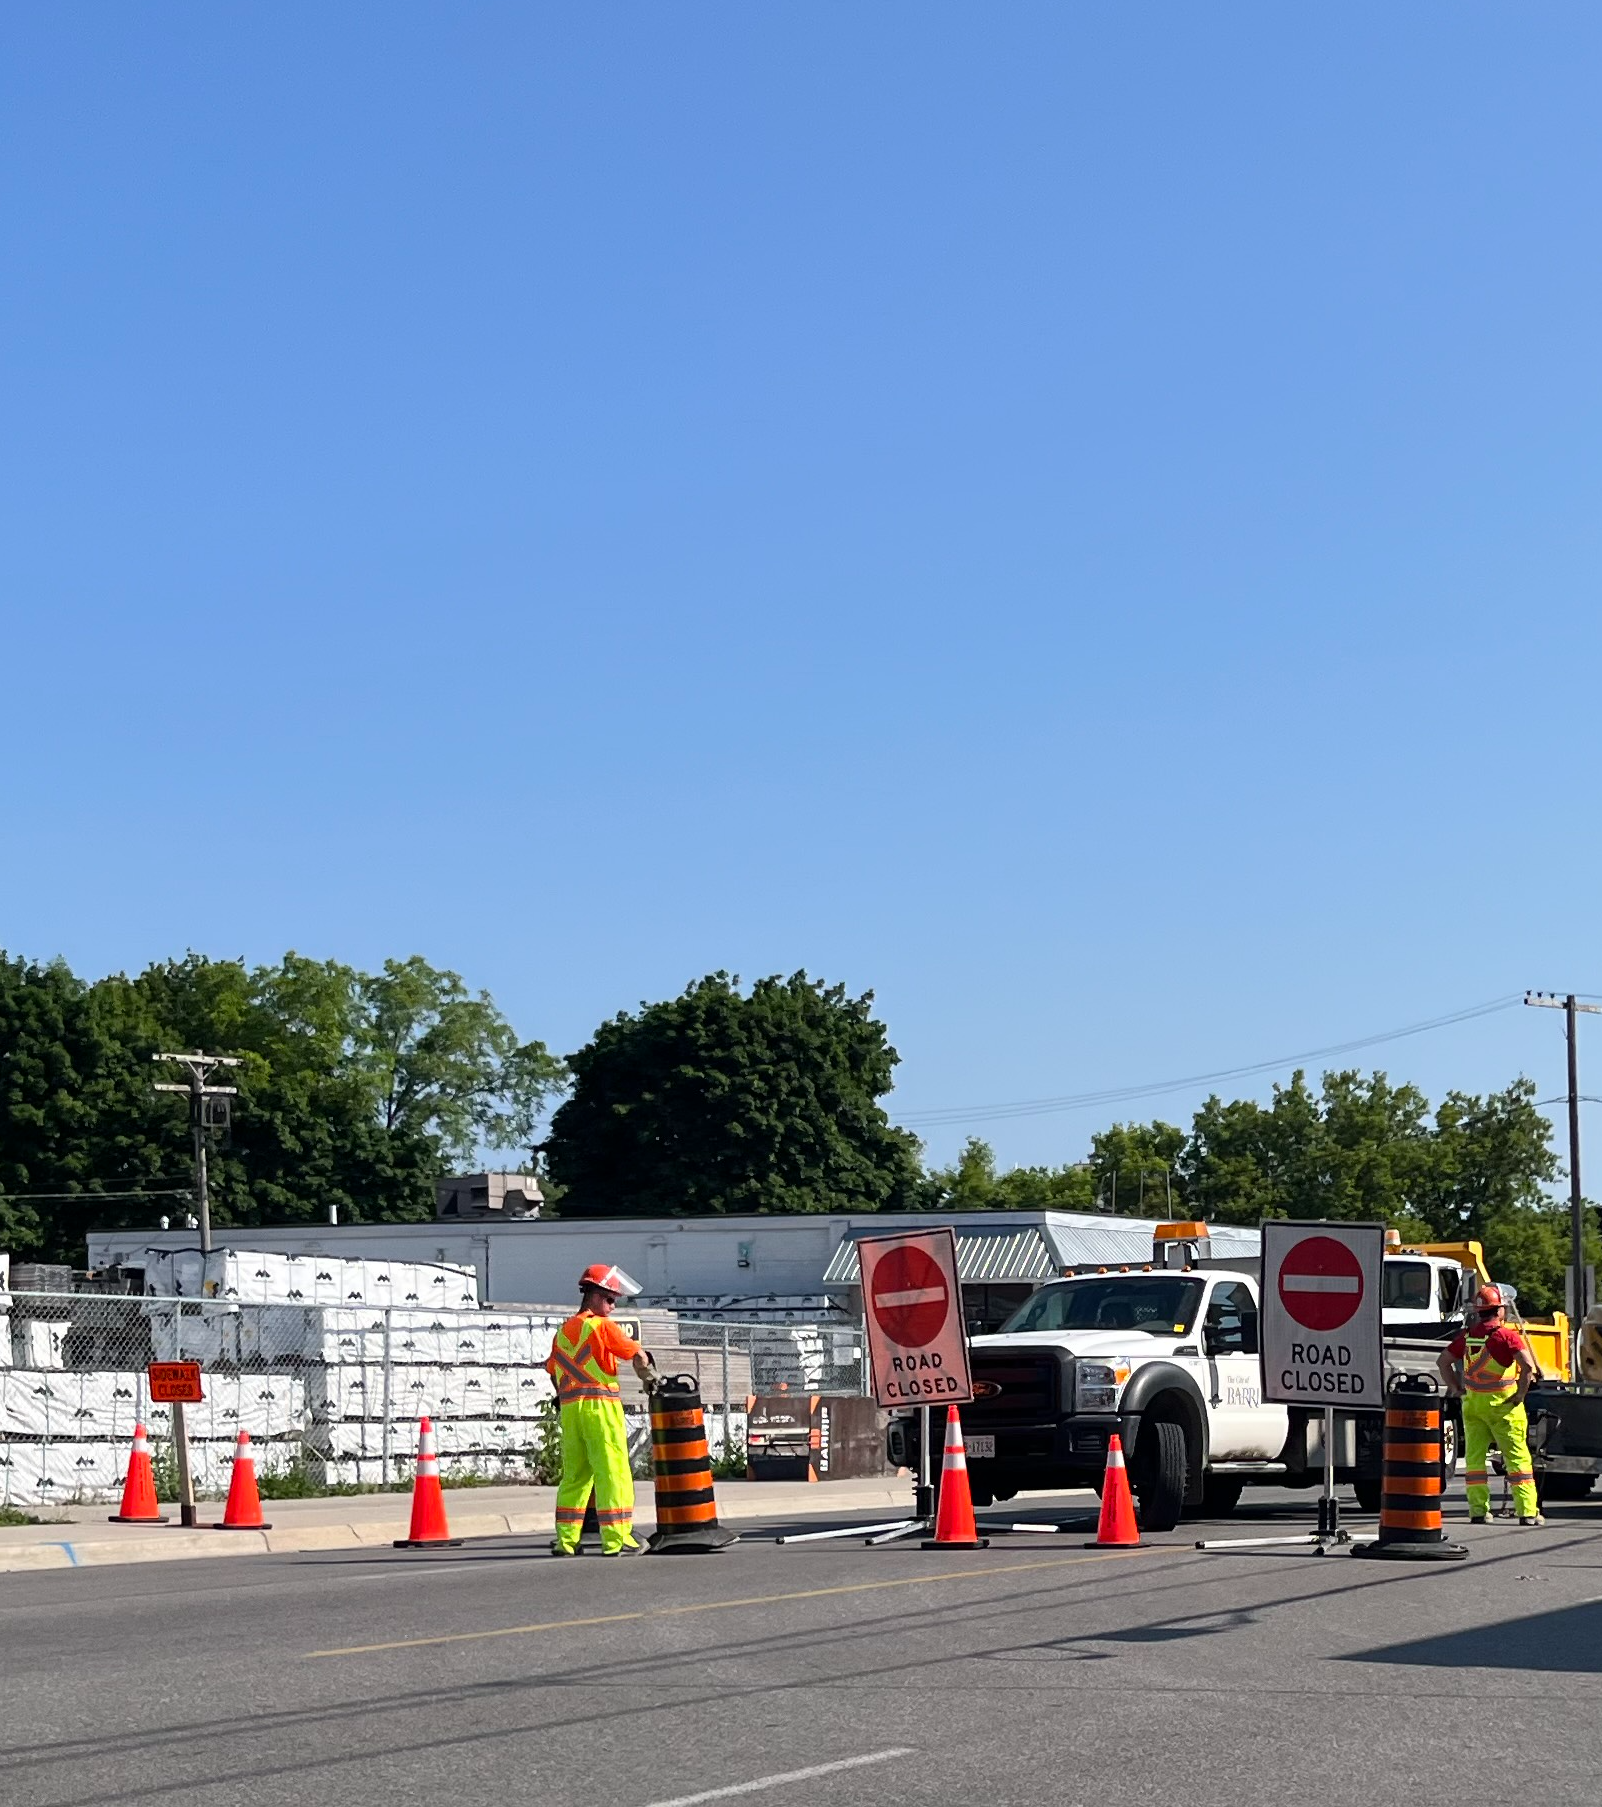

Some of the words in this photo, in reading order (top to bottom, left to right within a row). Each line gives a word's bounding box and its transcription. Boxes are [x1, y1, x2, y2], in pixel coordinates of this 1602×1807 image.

[892, 1353, 942, 1372] ROAD
[1291, 1343, 1351, 1366] ROAD
[158, 1384, 194, 1397] CLOSED
[886, 1376, 958, 1398] CLOSED
[1281, 1370, 1365, 1394] CLOSED
[1227, 1387, 1260, 1408] BARRI
